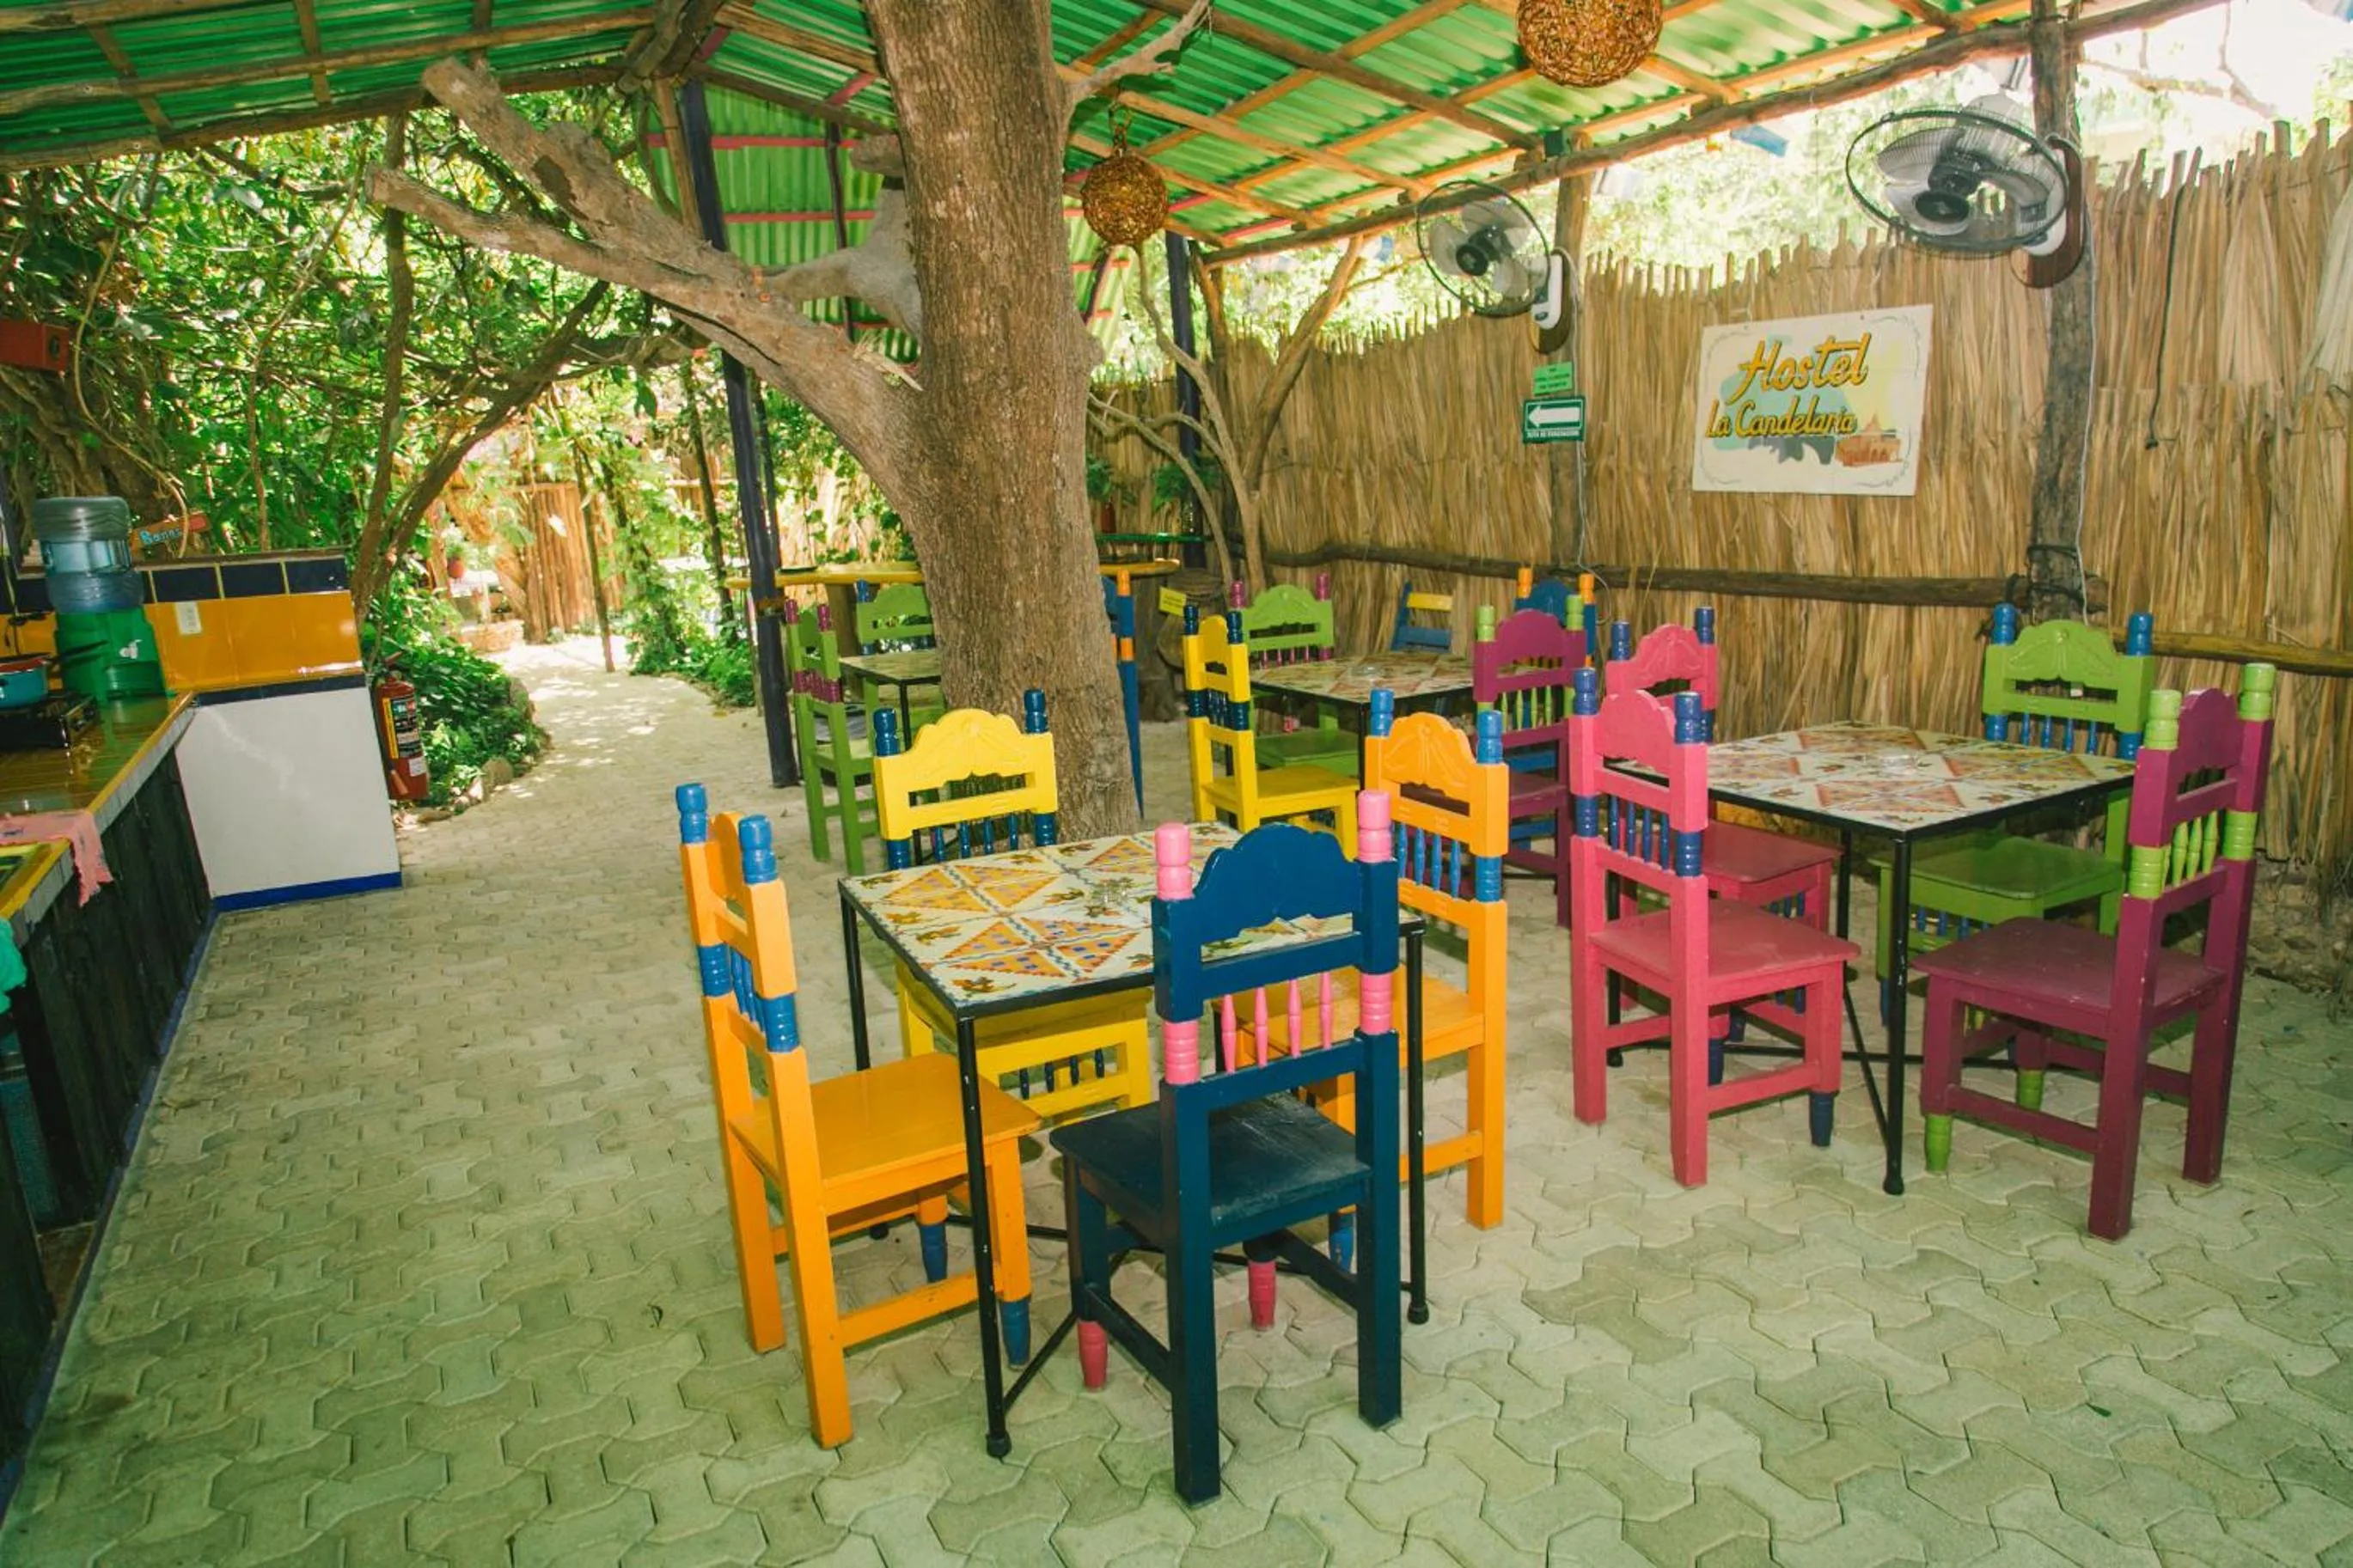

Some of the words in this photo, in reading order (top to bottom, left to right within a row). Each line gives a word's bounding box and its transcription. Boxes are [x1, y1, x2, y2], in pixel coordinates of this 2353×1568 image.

[1725, 332, 1872, 406] Hostel
[1705, 399, 1733, 437] La
[1734, 394, 1858, 437] Candelaria
